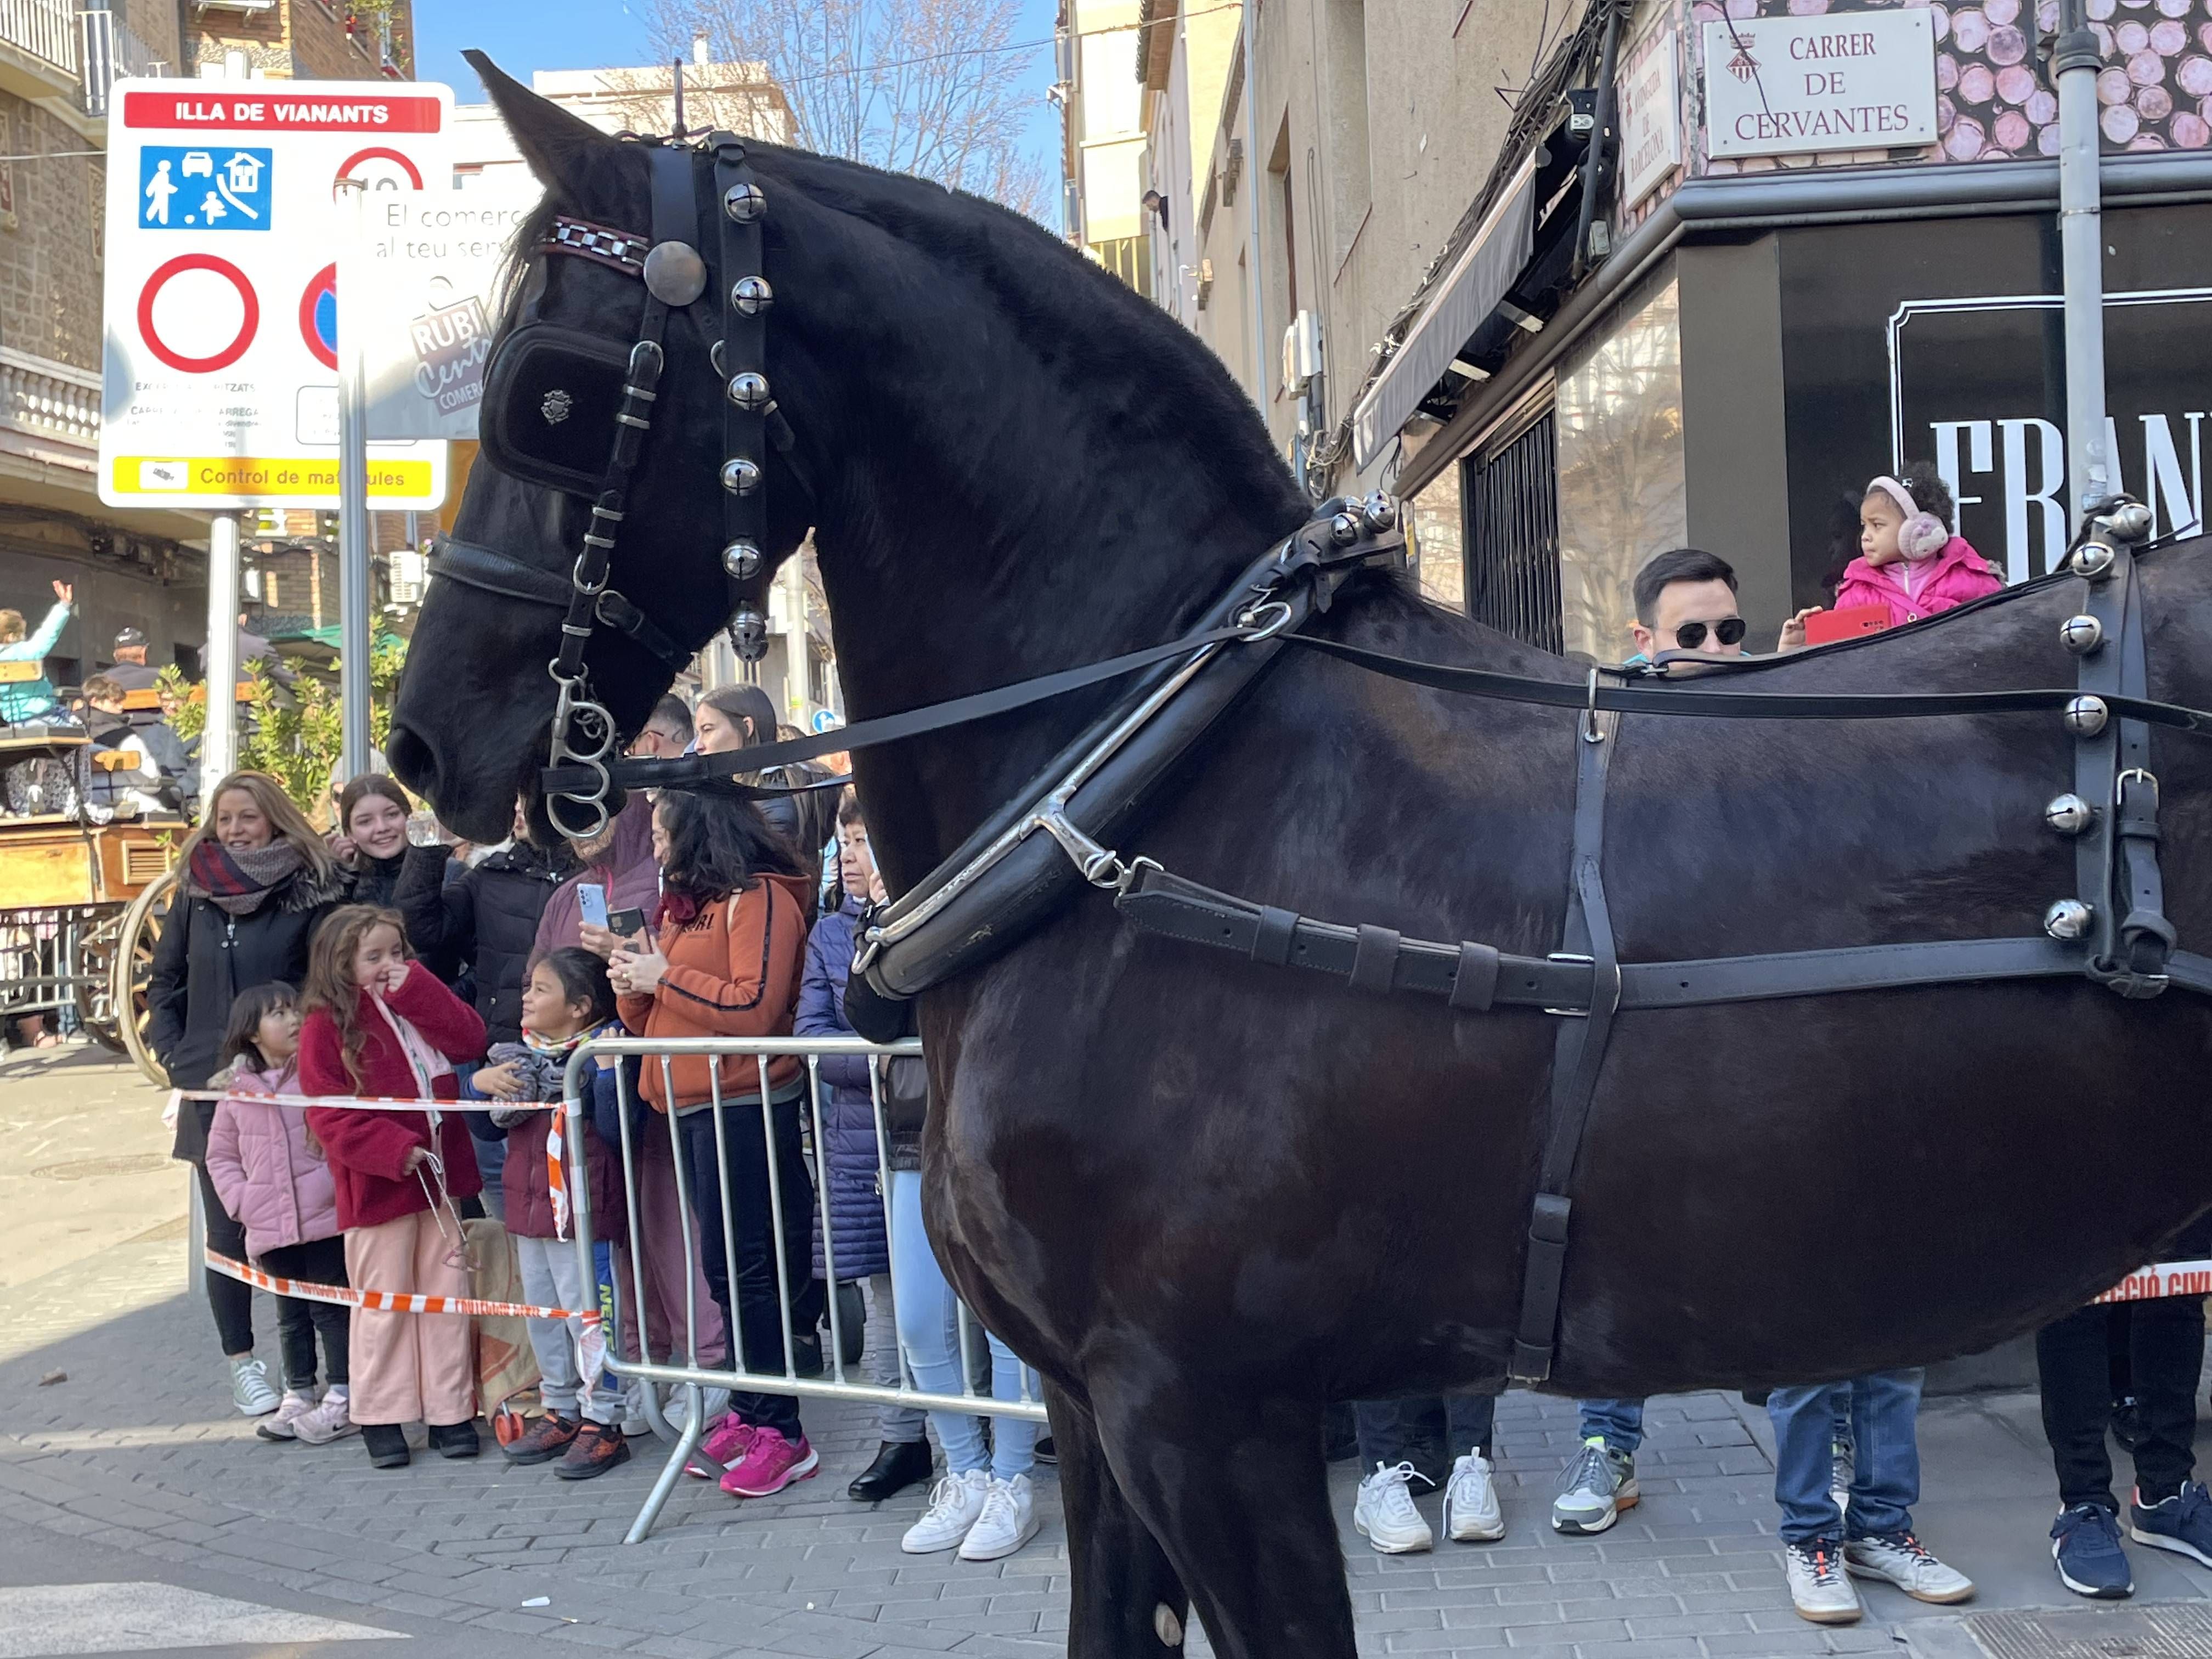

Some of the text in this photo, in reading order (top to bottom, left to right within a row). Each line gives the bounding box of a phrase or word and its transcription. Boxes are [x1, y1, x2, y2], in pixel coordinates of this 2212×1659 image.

[1790, 33, 1876, 60] CARRER
[1805, 72, 1846, 95] DE
[176, 102, 388, 123] ILLA DE VIANANTS
[1735, 105, 1908, 139] CERVANTES
[388, 204, 407, 226] El
[377, 236, 393, 257] al
[407, 242, 445, 258] teu
[201, 468, 268, 484] Control
[277, 470, 299, 484] de
